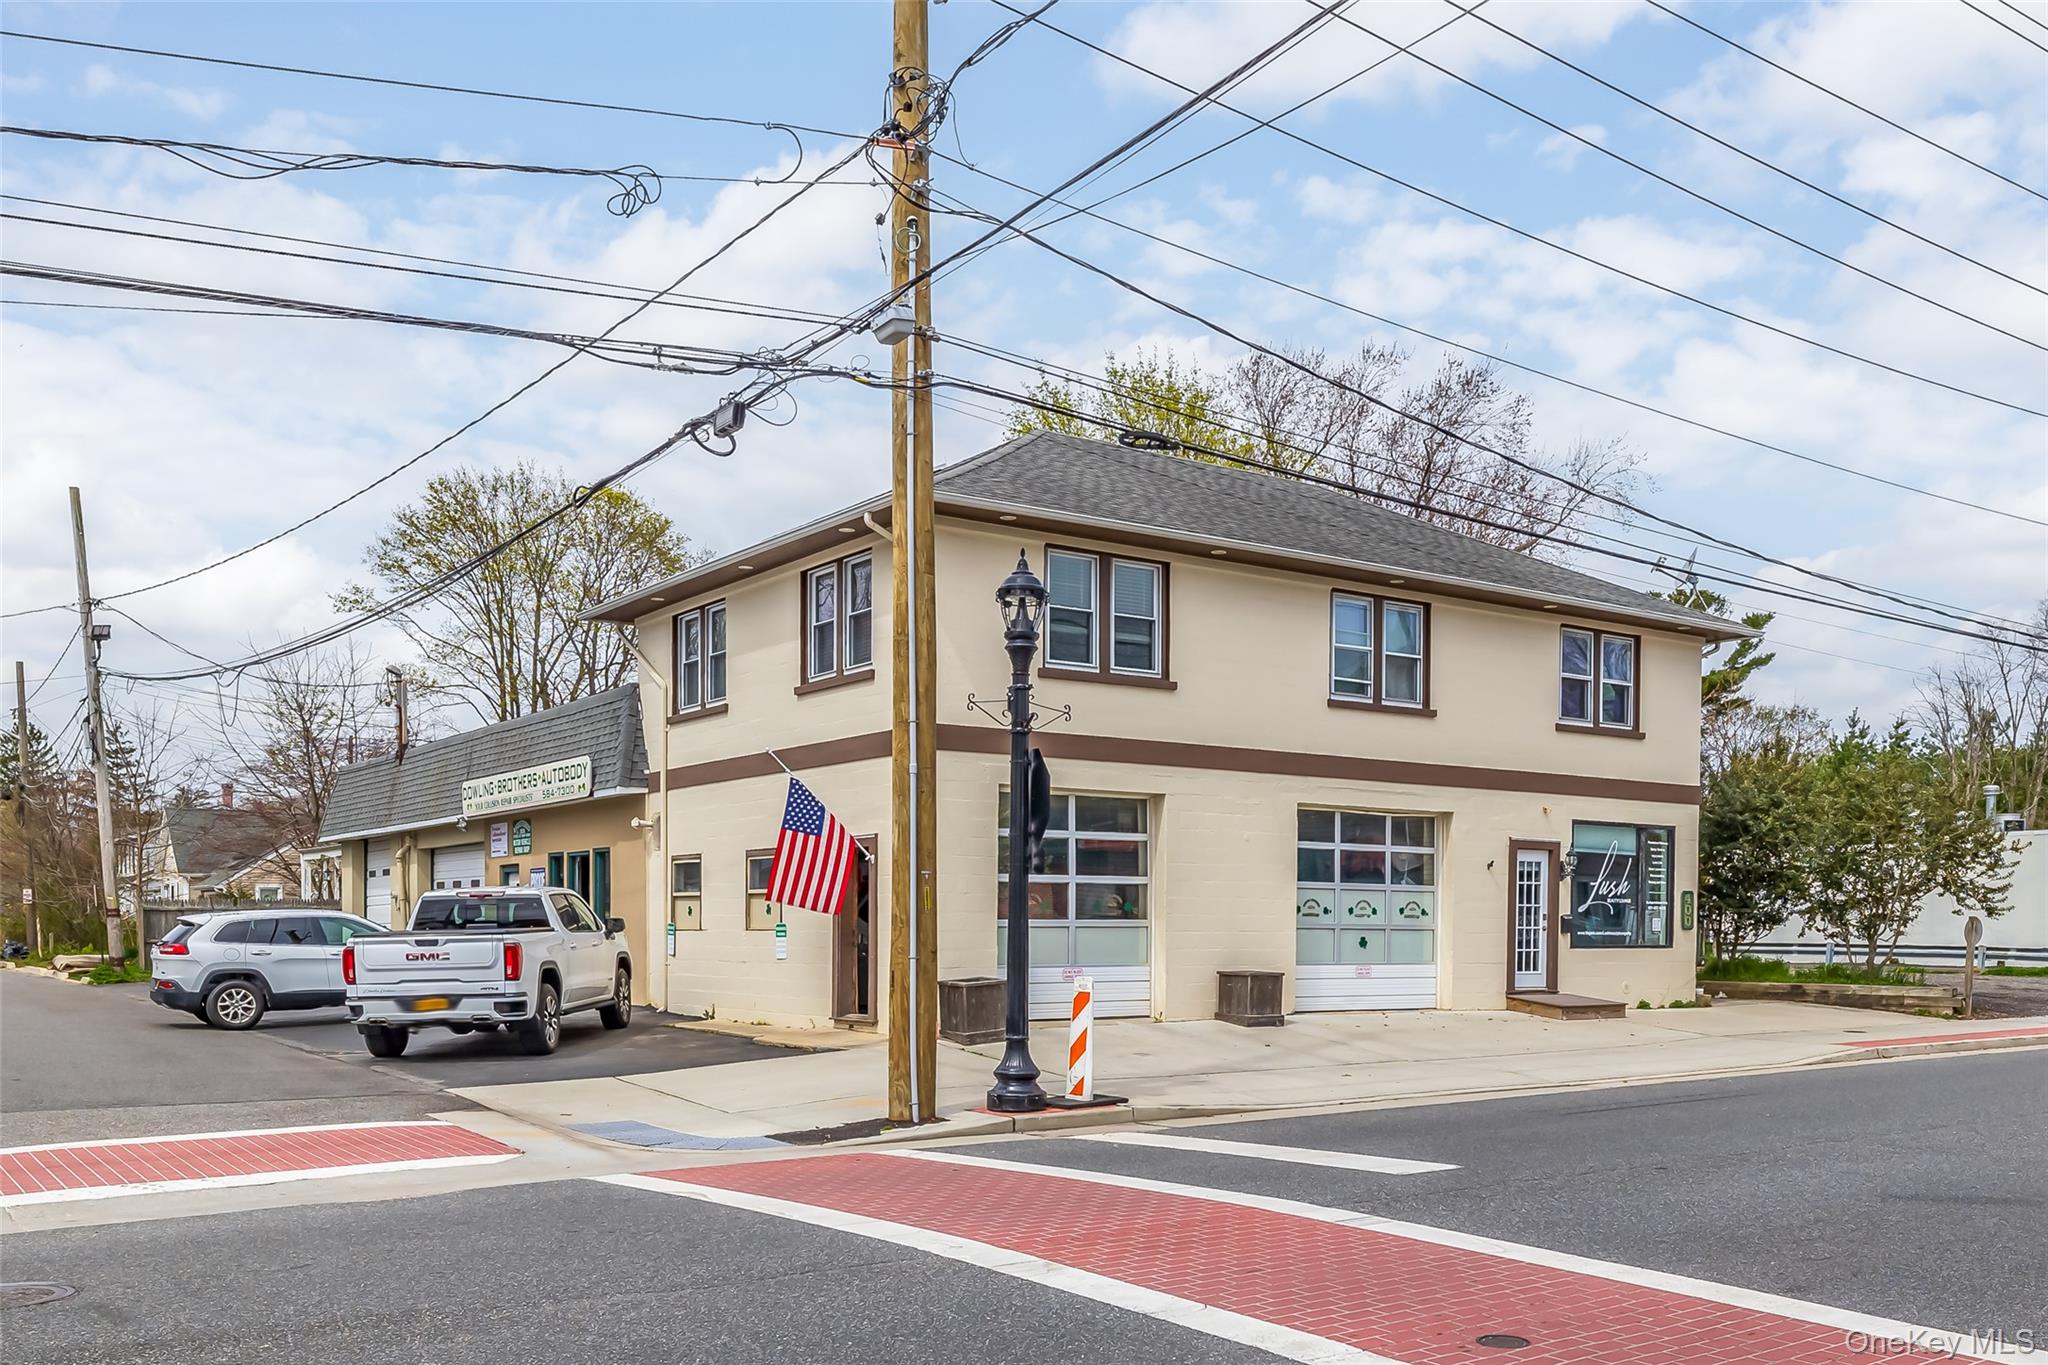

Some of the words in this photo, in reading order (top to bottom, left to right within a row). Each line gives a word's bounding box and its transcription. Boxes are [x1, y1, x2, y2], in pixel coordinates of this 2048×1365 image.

[463, 782, 495, 801] DOWLING
[497, 772, 538, 794] BROTHERS
[541, 761, 588, 786] AUTOBODY
[1577, 840, 1632, 915] Lush
[405, 952, 450, 962] GMC
